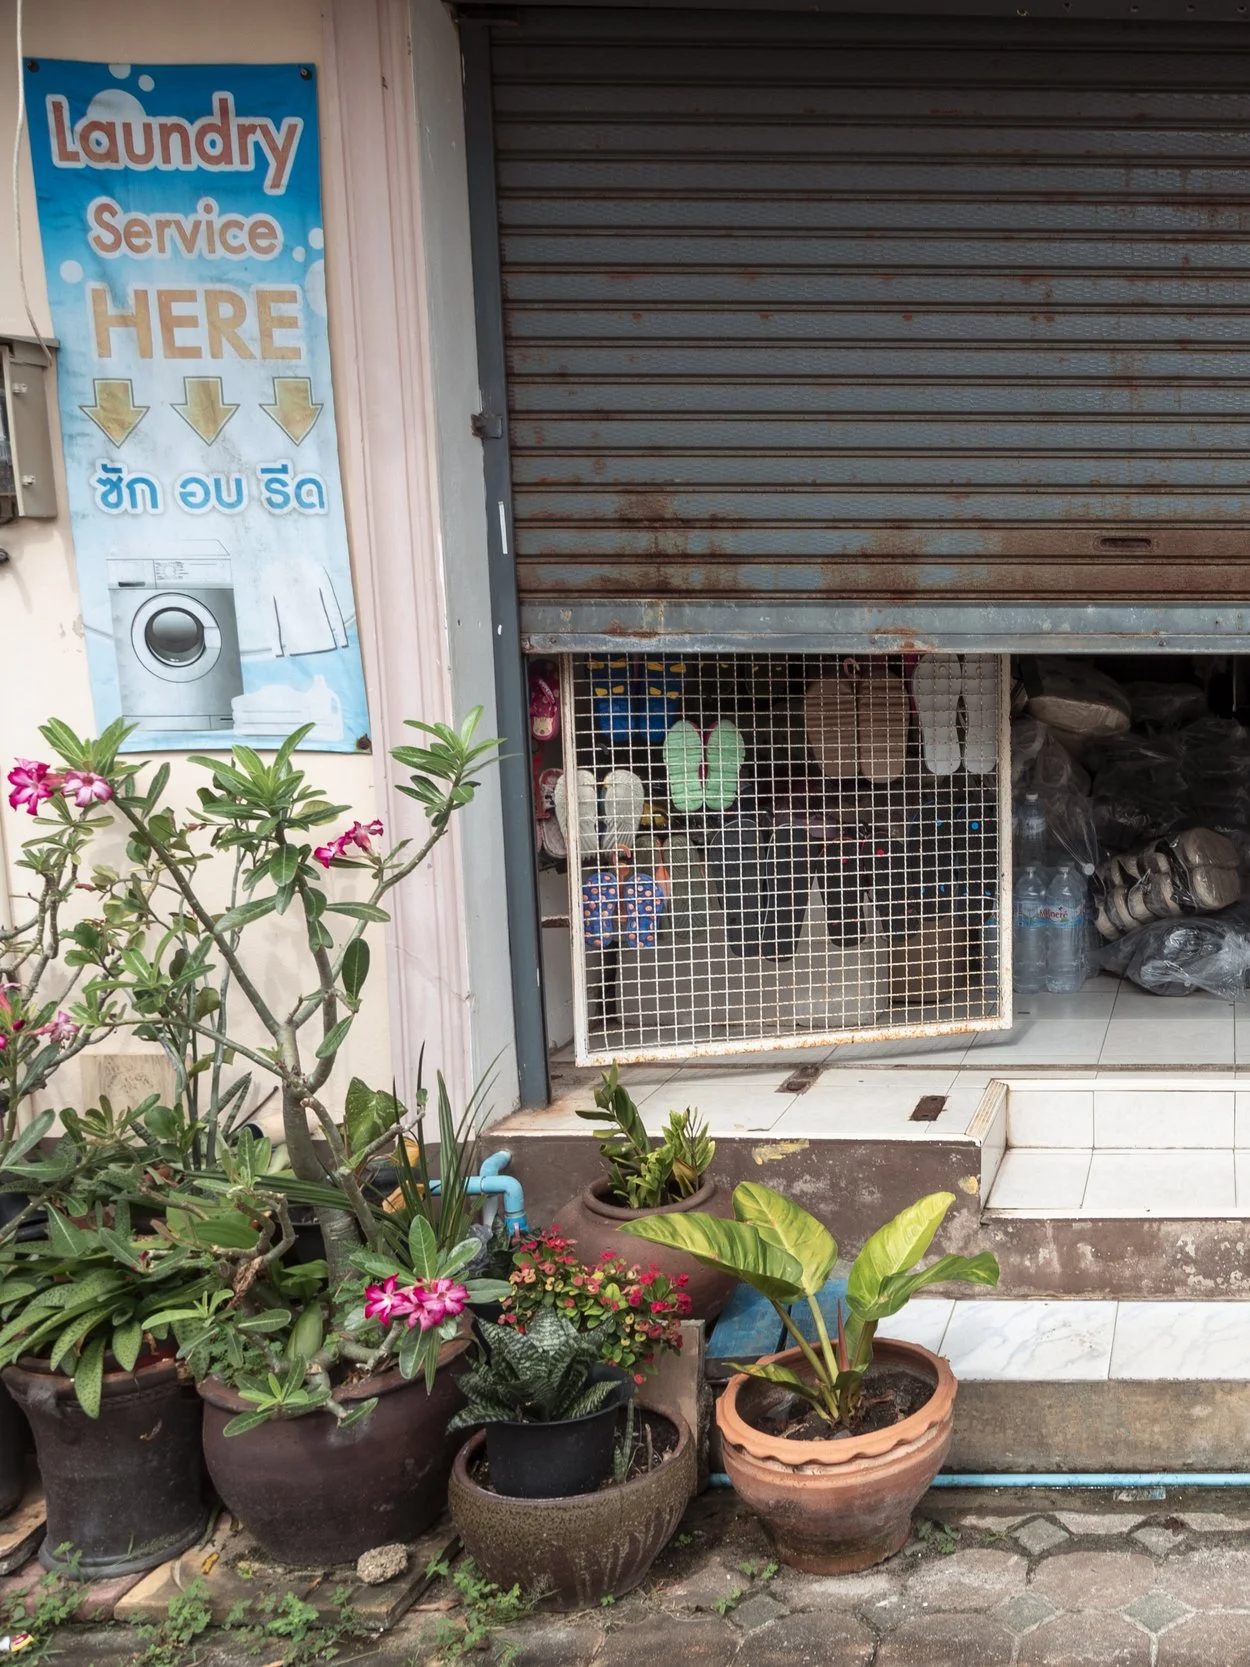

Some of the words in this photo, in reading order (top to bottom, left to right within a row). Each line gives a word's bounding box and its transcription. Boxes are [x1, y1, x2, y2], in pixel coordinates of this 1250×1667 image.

[50, 97, 299, 190] Laundry
[92, 202, 279, 255] Service
[90, 287, 302, 361] HERE
[97, 463, 159, 510] ซัก
[178, 476, 244, 510] อบ
[260, 463, 326, 510] รีด
